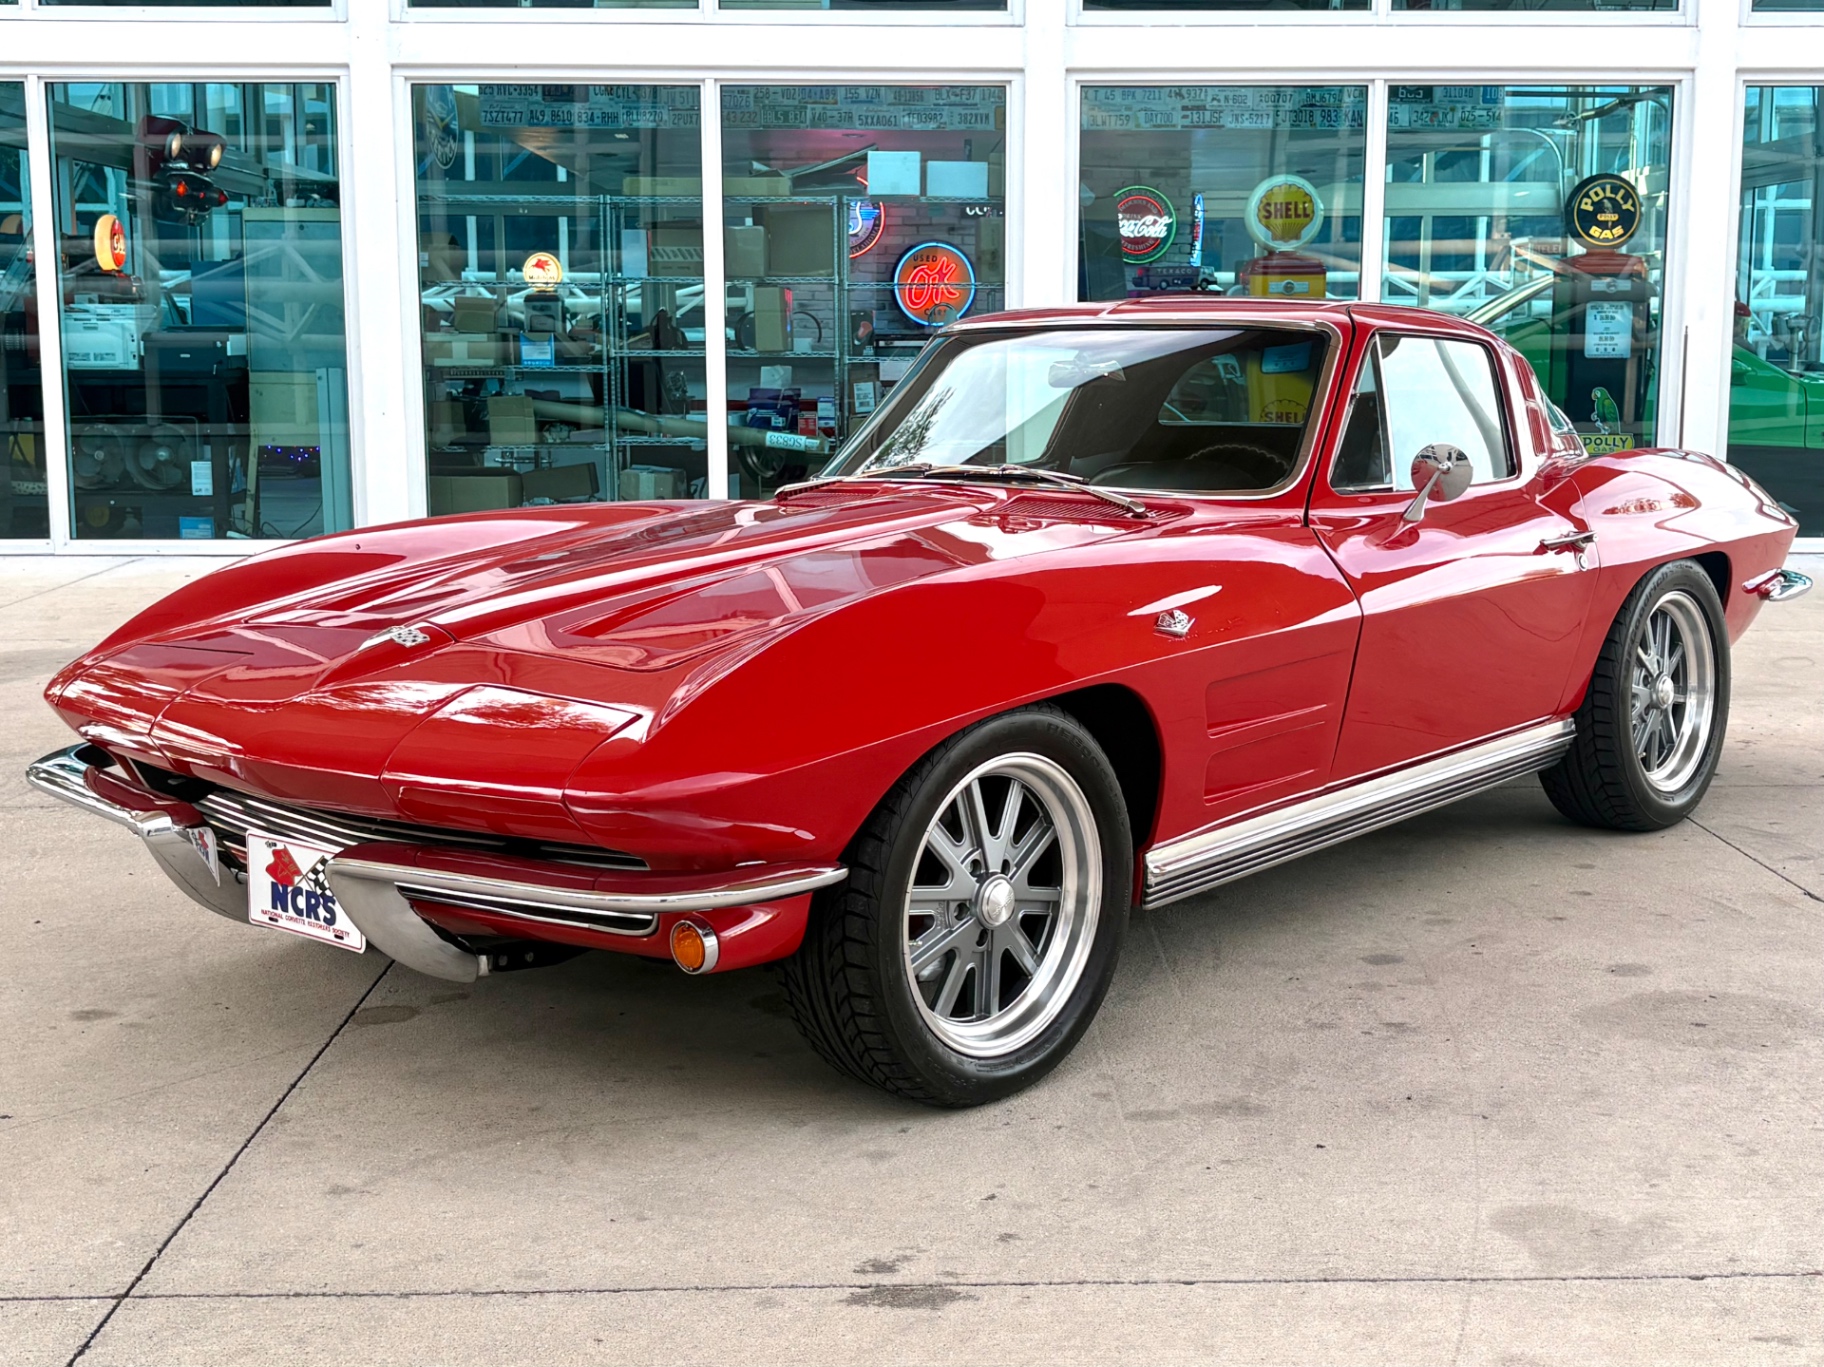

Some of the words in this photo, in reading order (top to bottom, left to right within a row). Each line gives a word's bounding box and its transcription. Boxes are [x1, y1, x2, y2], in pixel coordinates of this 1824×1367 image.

[1580, 184, 1635, 212] POLLY
[1262, 201, 1311, 220] SHELL
[1588, 225, 1625, 240] GAS
[913, 254, 938, 262] USED
[1583, 437, 1629, 448] POLLY
[270, 881, 337, 927] NCRS
